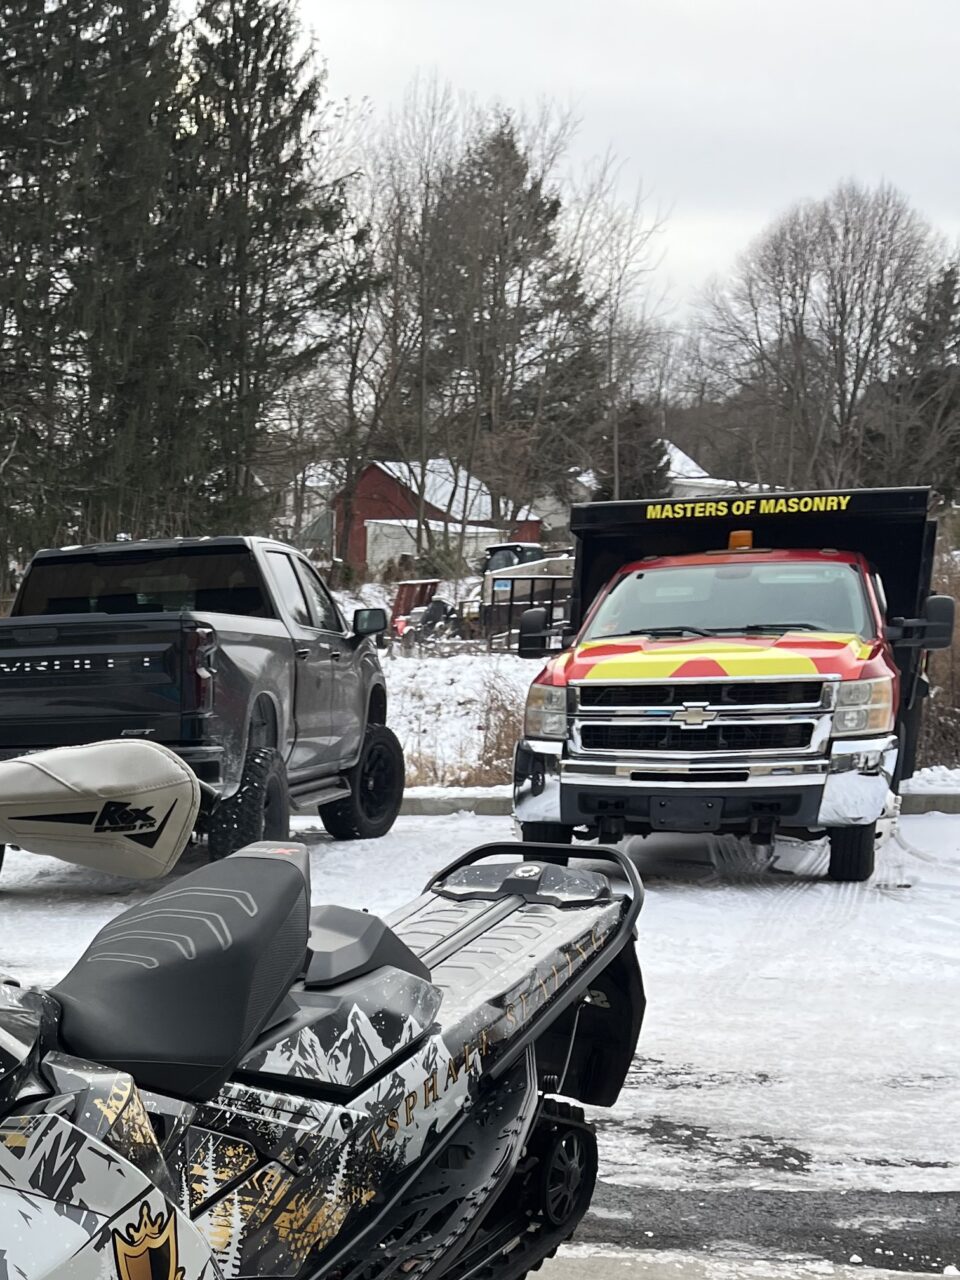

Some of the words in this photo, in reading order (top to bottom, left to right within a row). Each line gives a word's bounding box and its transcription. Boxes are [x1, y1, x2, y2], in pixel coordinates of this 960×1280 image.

[646, 501, 728, 519] MASTERS
[732, 500, 756, 516] OF
[759, 496, 851, 514] MASONRY
[369, 1031, 490, 1152] ASPHALT
